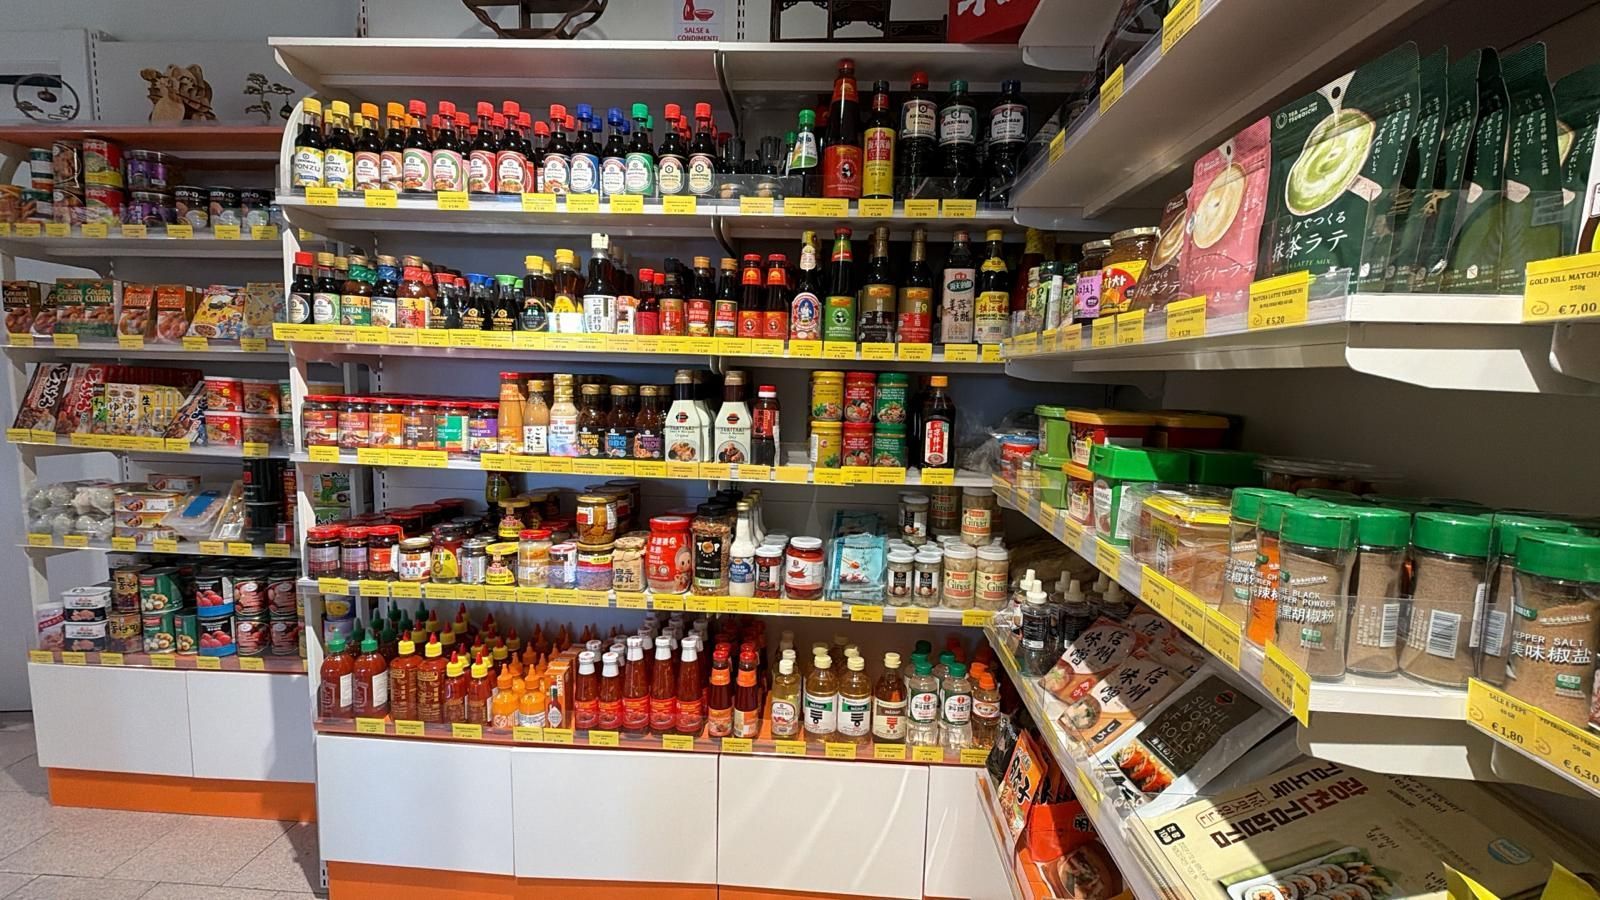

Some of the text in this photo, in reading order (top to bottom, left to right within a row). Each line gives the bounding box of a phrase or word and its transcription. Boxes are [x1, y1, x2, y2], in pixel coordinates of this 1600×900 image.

[1272, 229, 1348, 264] 抹茶ラテ
[1530, 278, 1548, 286] GOLD
[1550, 276, 1566, 284] KILL
[1559, 302, 1597, 315] € 7,00
[964, 517, 987, 528] Ginger
[948, 580, 971, 590] Ginger
[1292, 590, 1320, 600] BLACK
[1302, 599, 1336, 608] POWDER
[1512, 630, 1584, 647] PEPPER SALT
[1512, 640, 1592, 664] 美味椒盐
[1192, 696, 1229, 723] SUSHI
[1489, 692, 1505, 705] SALE
[1510, 704, 1527, 715] PEPE
[1170, 712, 1206, 744] FOR
[1181, 703, 1216, 734] NORI
[1160, 722, 1196, 754] ROLLS
[1492, 722, 1524, 744] € 1,80
[1564, 759, 1600, 784] € 6,30
[1210, 776, 1369, 849] 광천김밥김
